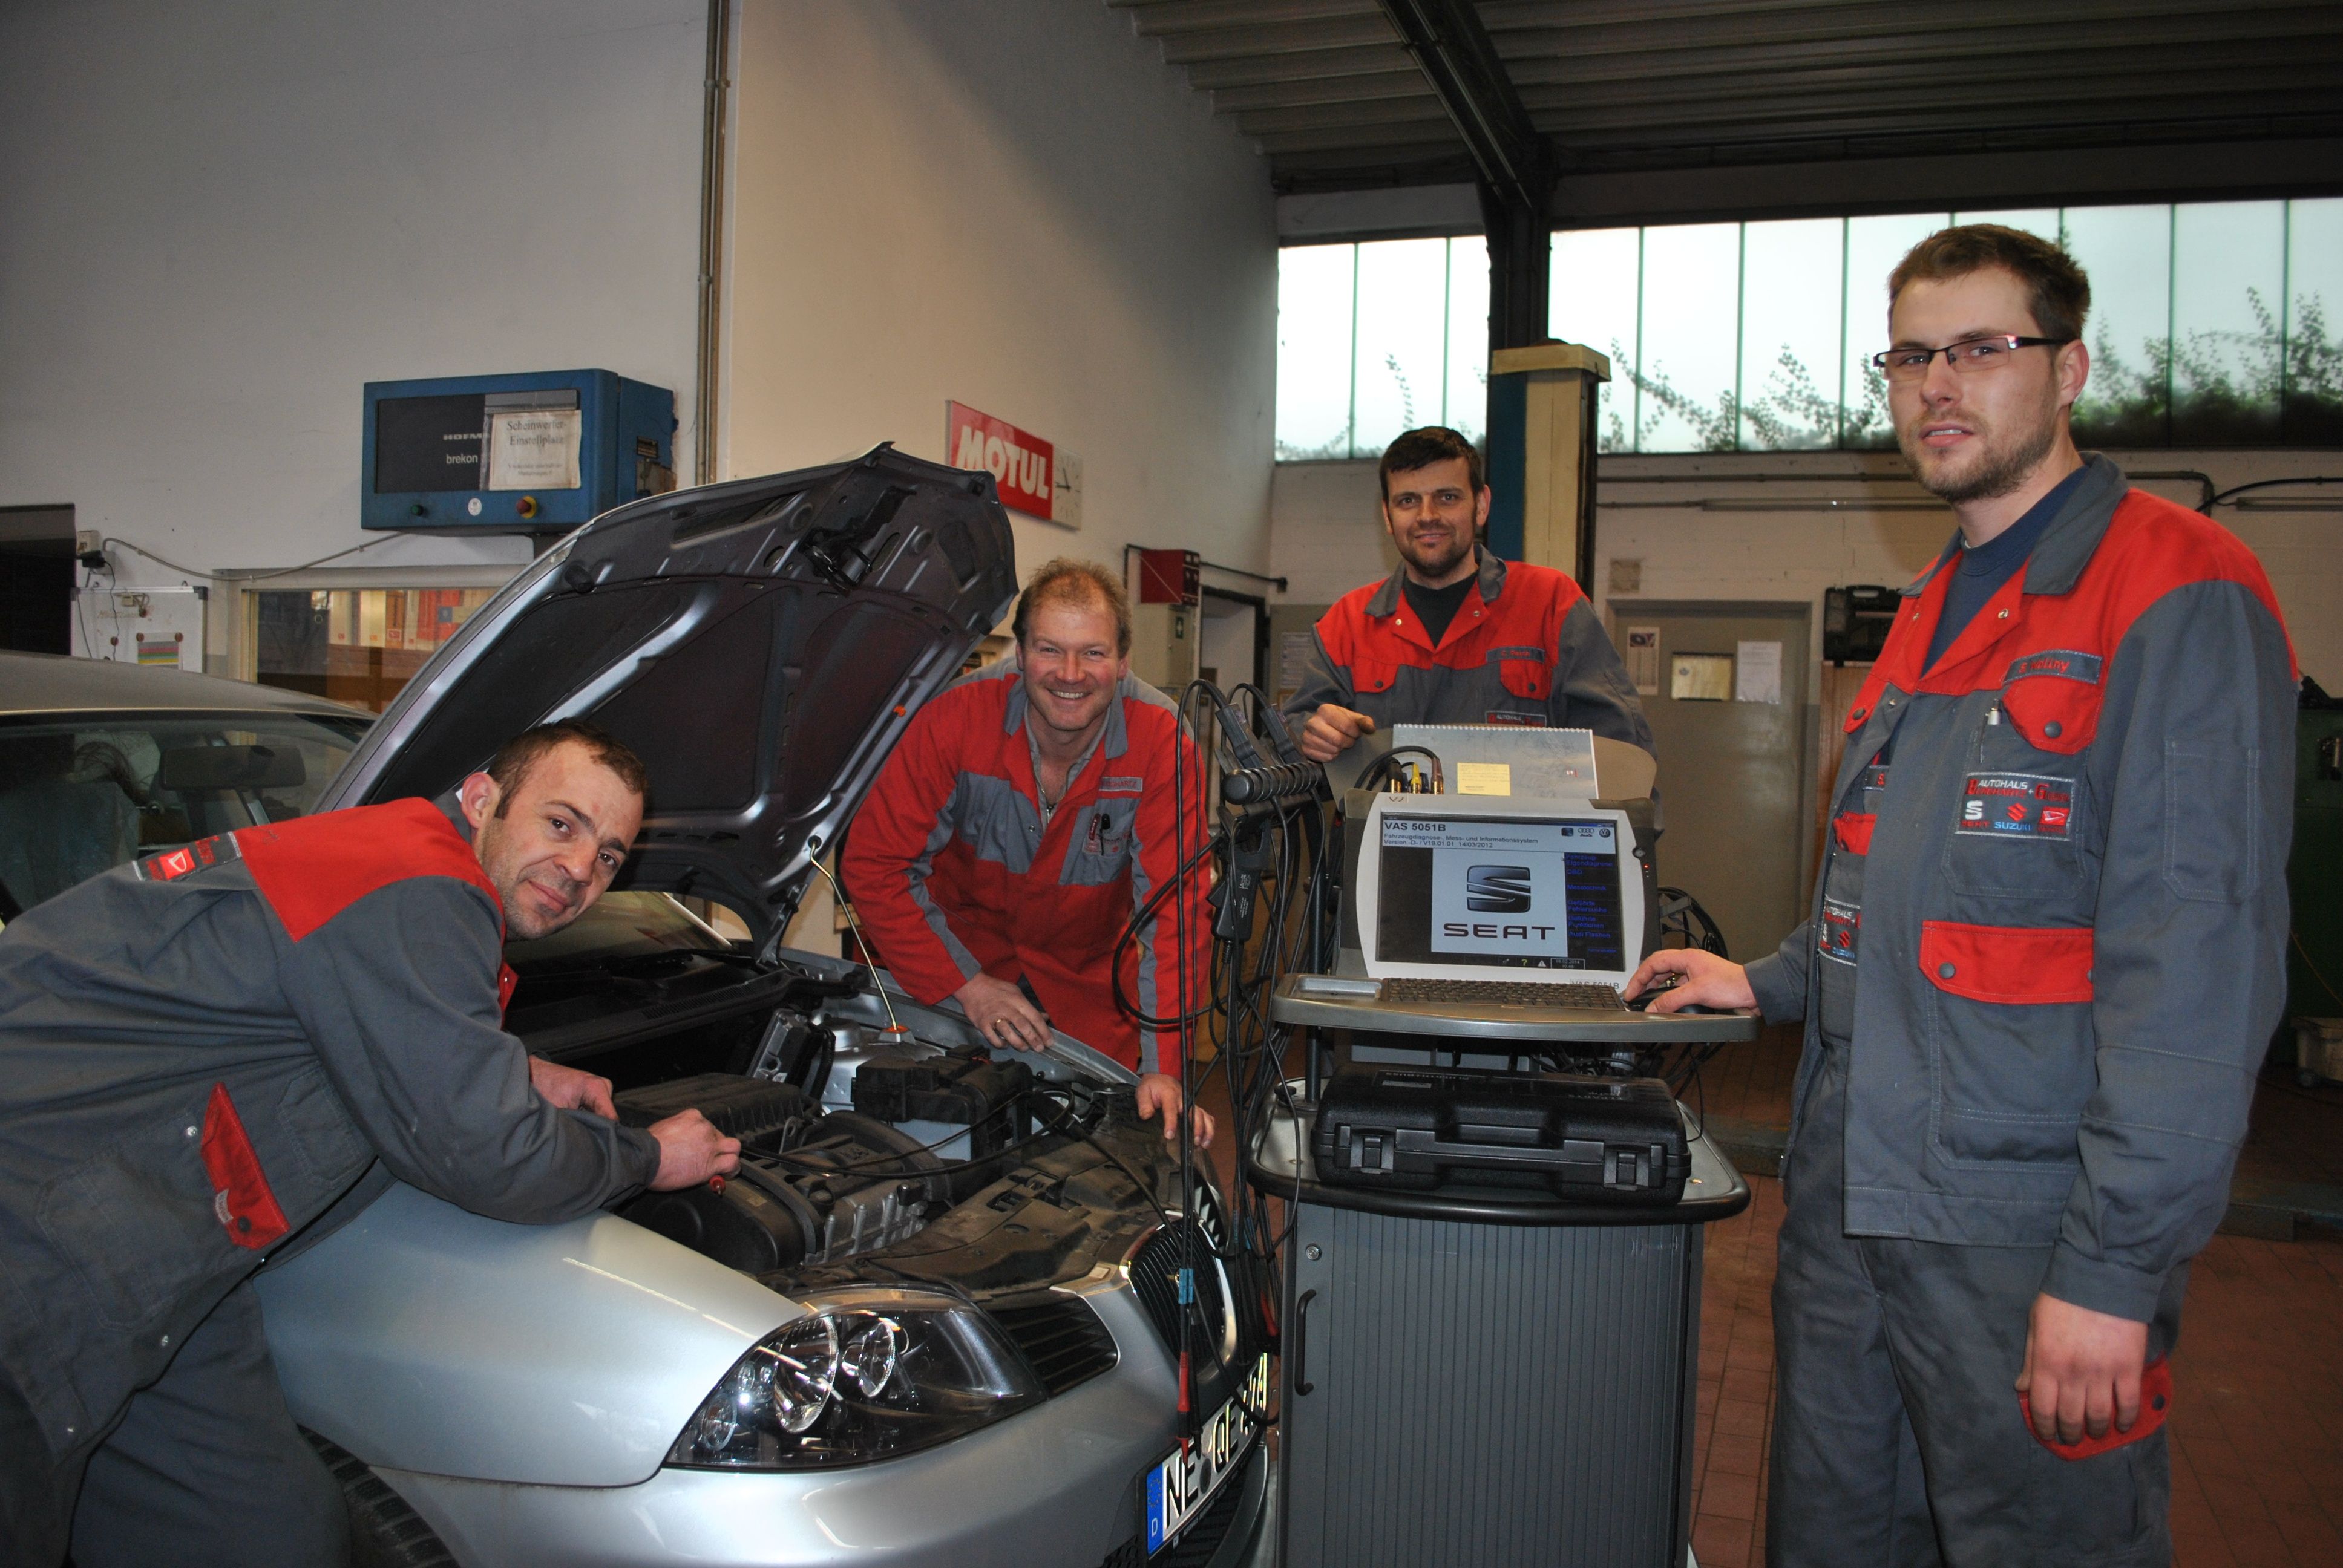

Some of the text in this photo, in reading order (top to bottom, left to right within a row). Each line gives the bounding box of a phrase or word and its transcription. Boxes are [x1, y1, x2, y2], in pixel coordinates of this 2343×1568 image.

[446, 453, 478, 464] brekon
[956, 425, 1050, 500] MOTUL
[1978, 779, 2028, 789] AUTOHAUS
[1384, 822, 1446, 832] VAS 5051B
[1994, 822, 2031, 831] SUZUKI
[1443, 923, 1555, 941] SEAT
[1163, 1437, 1199, 1530] NE
[1152, 1517, 1158, 1537] D
